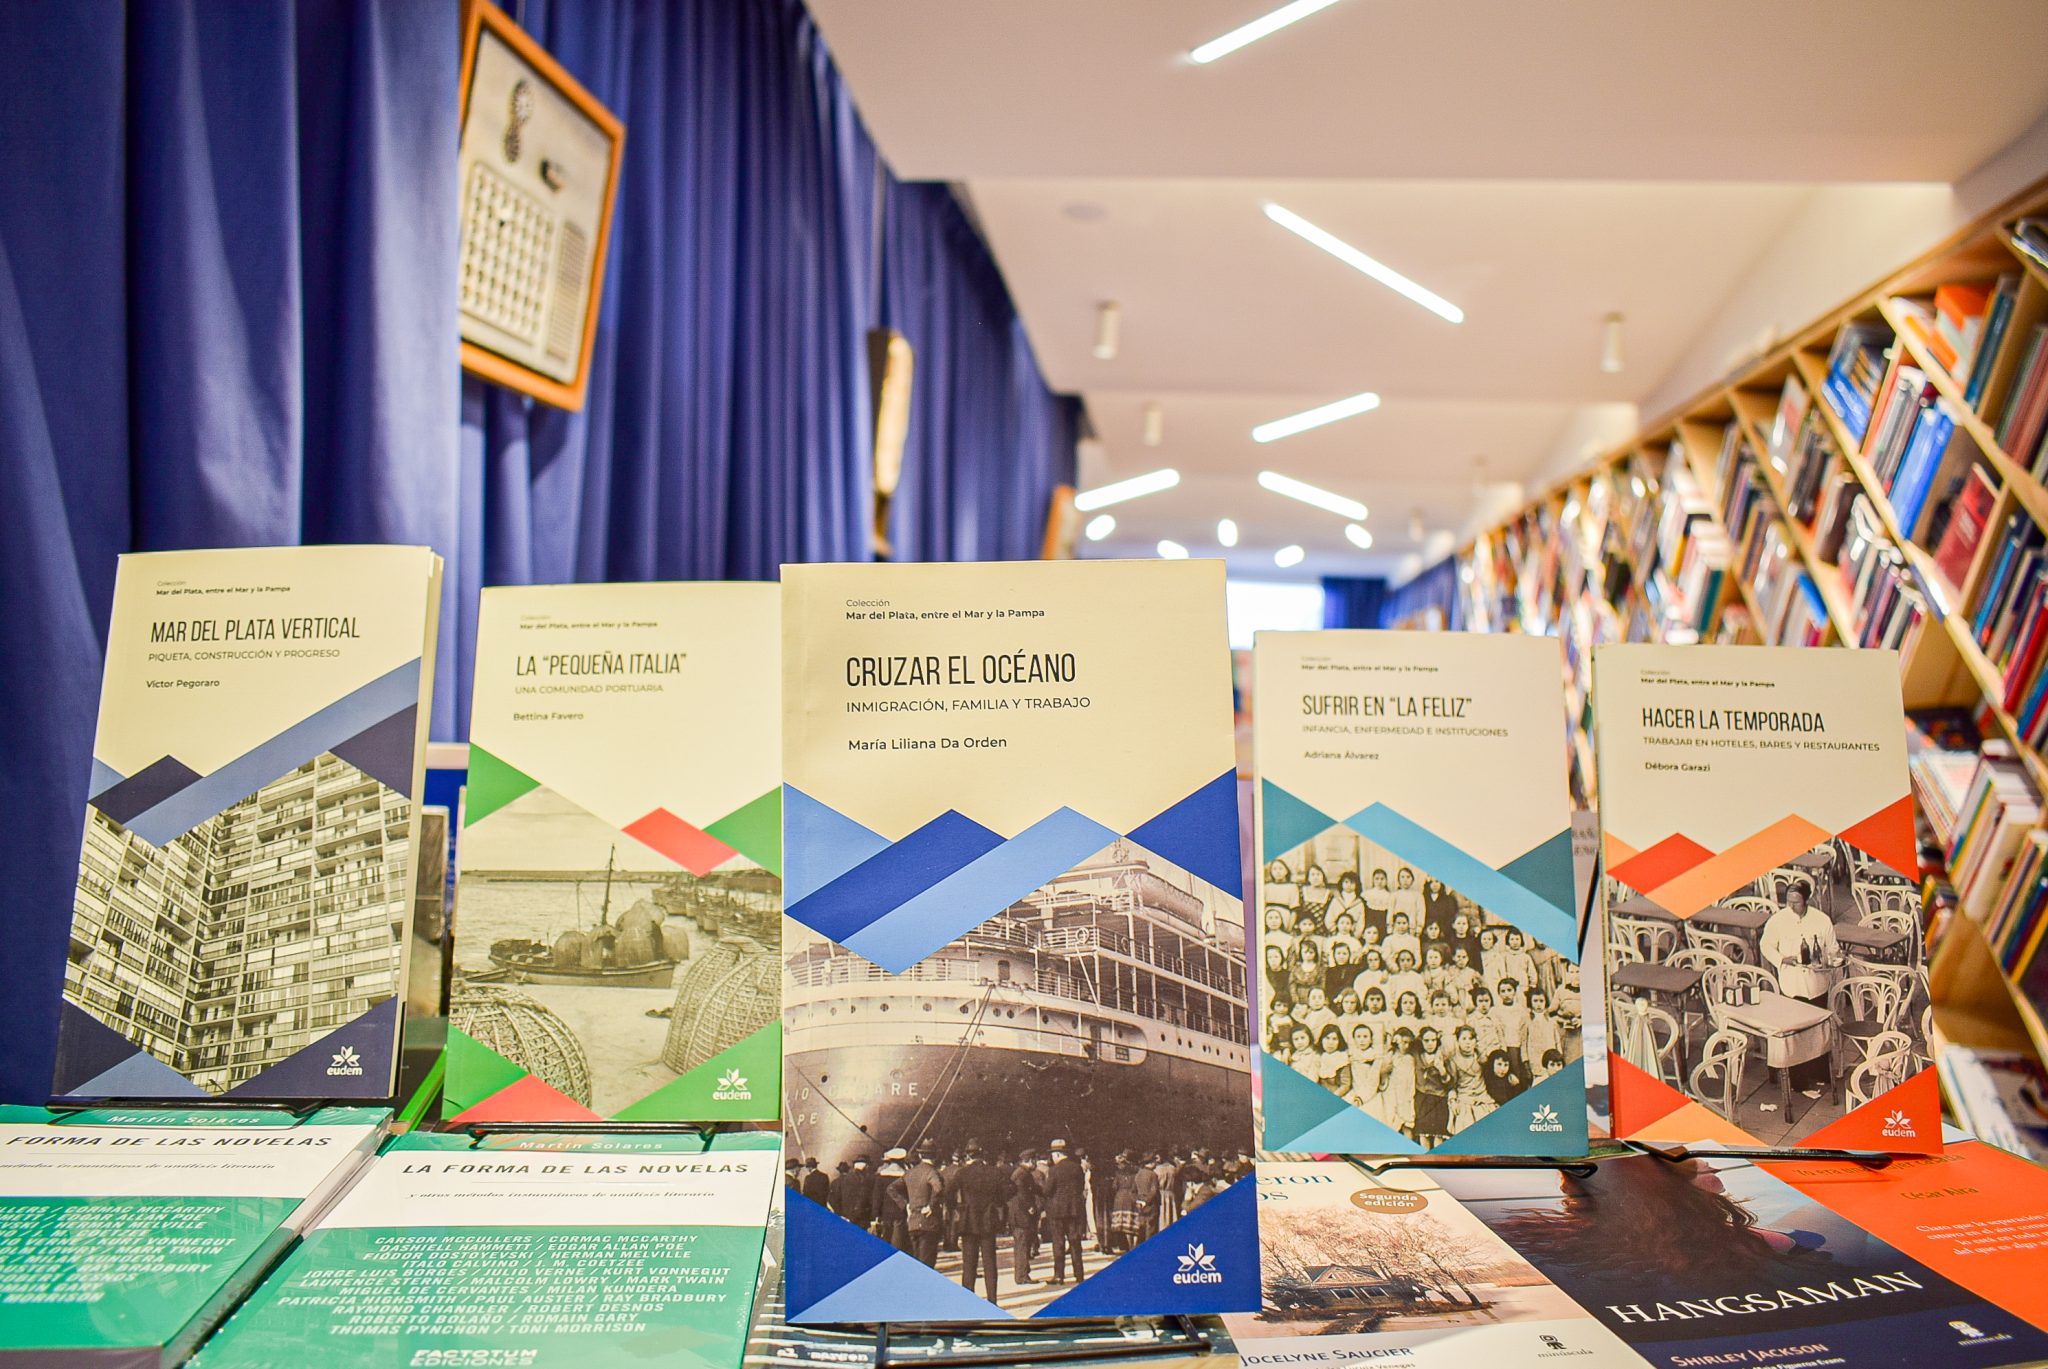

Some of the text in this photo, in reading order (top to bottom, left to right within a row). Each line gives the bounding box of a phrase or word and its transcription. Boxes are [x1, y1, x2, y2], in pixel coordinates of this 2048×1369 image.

[184, 588, 204, 596] Plata,
[846, 599, 890, 607] Colección
[846, 609, 1045, 621] Mar del Plata, entre el Mar y la Pampa
[151, 617, 360, 643] MAR DEL PLATA VERTICAL
[149, 649, 340, 662] PIQUETA, CONSTRUCCIÓN Y PROGRESO
[517, 656, 536, 676] LA
[847, 649, 1076, 687] CRUZAR EL OCÉANO
[146, 679, 220, 689] Víctor Pegoraro
[515, 684, 663, 695] UNA COMUNIDAD PORTUARIA
[847, 697, 1091, 713] INMIGRACIÓN, FAMILIA Y TRABAJO
[1302, 695, 1359, 716] SUFRIR
[1364, 696, 1384, 716] EN
[513, 712, 584, 721] Bettina Favero
[1642, 708, 1825, 733] HACER LA TEMPORADA
[1302, 725, 1508, 737] INFANCIA, ENFERMEDAD E INSTITUCIONES
[849, 737, 1007, 751] María Liliana Da Orden
[1643, 737, 1880, 752] TRABAJAR EN HOTELES, BARES Y RESTAURANTES
[1304, 750, 1379, 760] Adriana Álvarez
[1645, 761, 1711, 772] Débora Garazi
[327, 1065, 363, 1076] eudem
[712, 1089, 752, 1100] eudem
[1529, 1122, 1563, 1132] eudem
[1882, 1128, 1916, 1137] eudem
[6, 1137, 332, 1146] FORMA DE LAS NOVELAS
[591, 1142, 663, 1150] Solares
[402, 1164, 748, 1174] LA FORMA DE LAS NOVELAS
[1359, 1192, 1418, 1201] Segunda
[1364, 1199, 1415, 1208] edición
[375, 1235, 698, 1245] CARSON MCCULLERS CORMAC MCCARTHY
[380, 1244, 455, 1252] DASHIELL
[460, 1243, 533, 1251] HAMMETT
[548, 1243, 602, 1251] EDGAR
[363, 1251, 691, 1260] FIÓDOR DOSTOYEVSKI HERMAN MELVILLE
[402, 1260, 447, 1268] ITALO
[452, 1259, 519, 1267] CALVINO
[578, 1259, 646, 1267] COETZEE
[303, 1268, 731, 1279] JORGE LUIS BORGES JULIO VERNE KURT VONNEGUT
[1173, 1269, 1222, 1284] eudem
[300, 1276, 726, 1287] LAURENCE STERNE MALCOLM LOWRY MARK TWAIN
[339, 1287, 401, 1295] MIGUEL
[408, 1286, 429, 1295] DE
[435, 1286, 529, 1294] CERVANTES
[603, 1285, 677, 1293] KUNDERA
[278, 1294, 727, 1306] PATRICIA HIGHSMITH PAUL AUSTER RAY BRADBURY
[1606, 1271, 1924, 1324] HANGSAMAN
[332, 1303, 665, 1315] RAYMOND CHANDLER ROBERT DESNOS
[348, 1313, 638, 1324] ROBERTO BOLAÑO ROMAIN GARY
[329, 1323, 646, 1335] THOMAS PYNCHON TONI MORRISON
[415, 1350, 538, 1358] FACTOTUM
[1240, 1352, 1330, 1367] JOCELYNE
[1333, 1348, 1414, 1360] SAUCIER
[1670, 1352, 1748, 1367] SHIRLEY
[1748, 1344, 1830, 1362] JACKSON
[409, 1358, 534, 1367] EDICIONES
